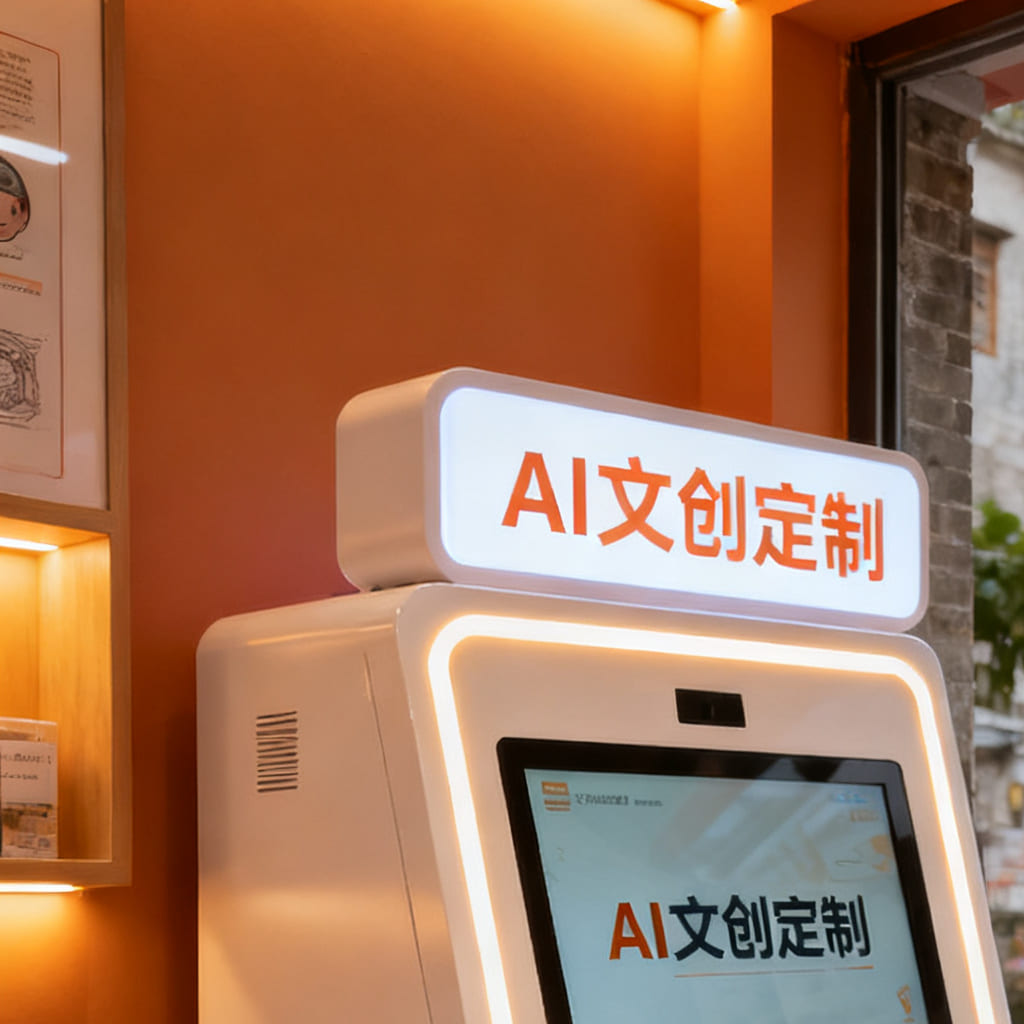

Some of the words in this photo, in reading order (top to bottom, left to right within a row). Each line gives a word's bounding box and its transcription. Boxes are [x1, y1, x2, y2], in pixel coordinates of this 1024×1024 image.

[502, 451, 884, 581] AI文创定制
[609, 894, 871, 961] AI文创定制
